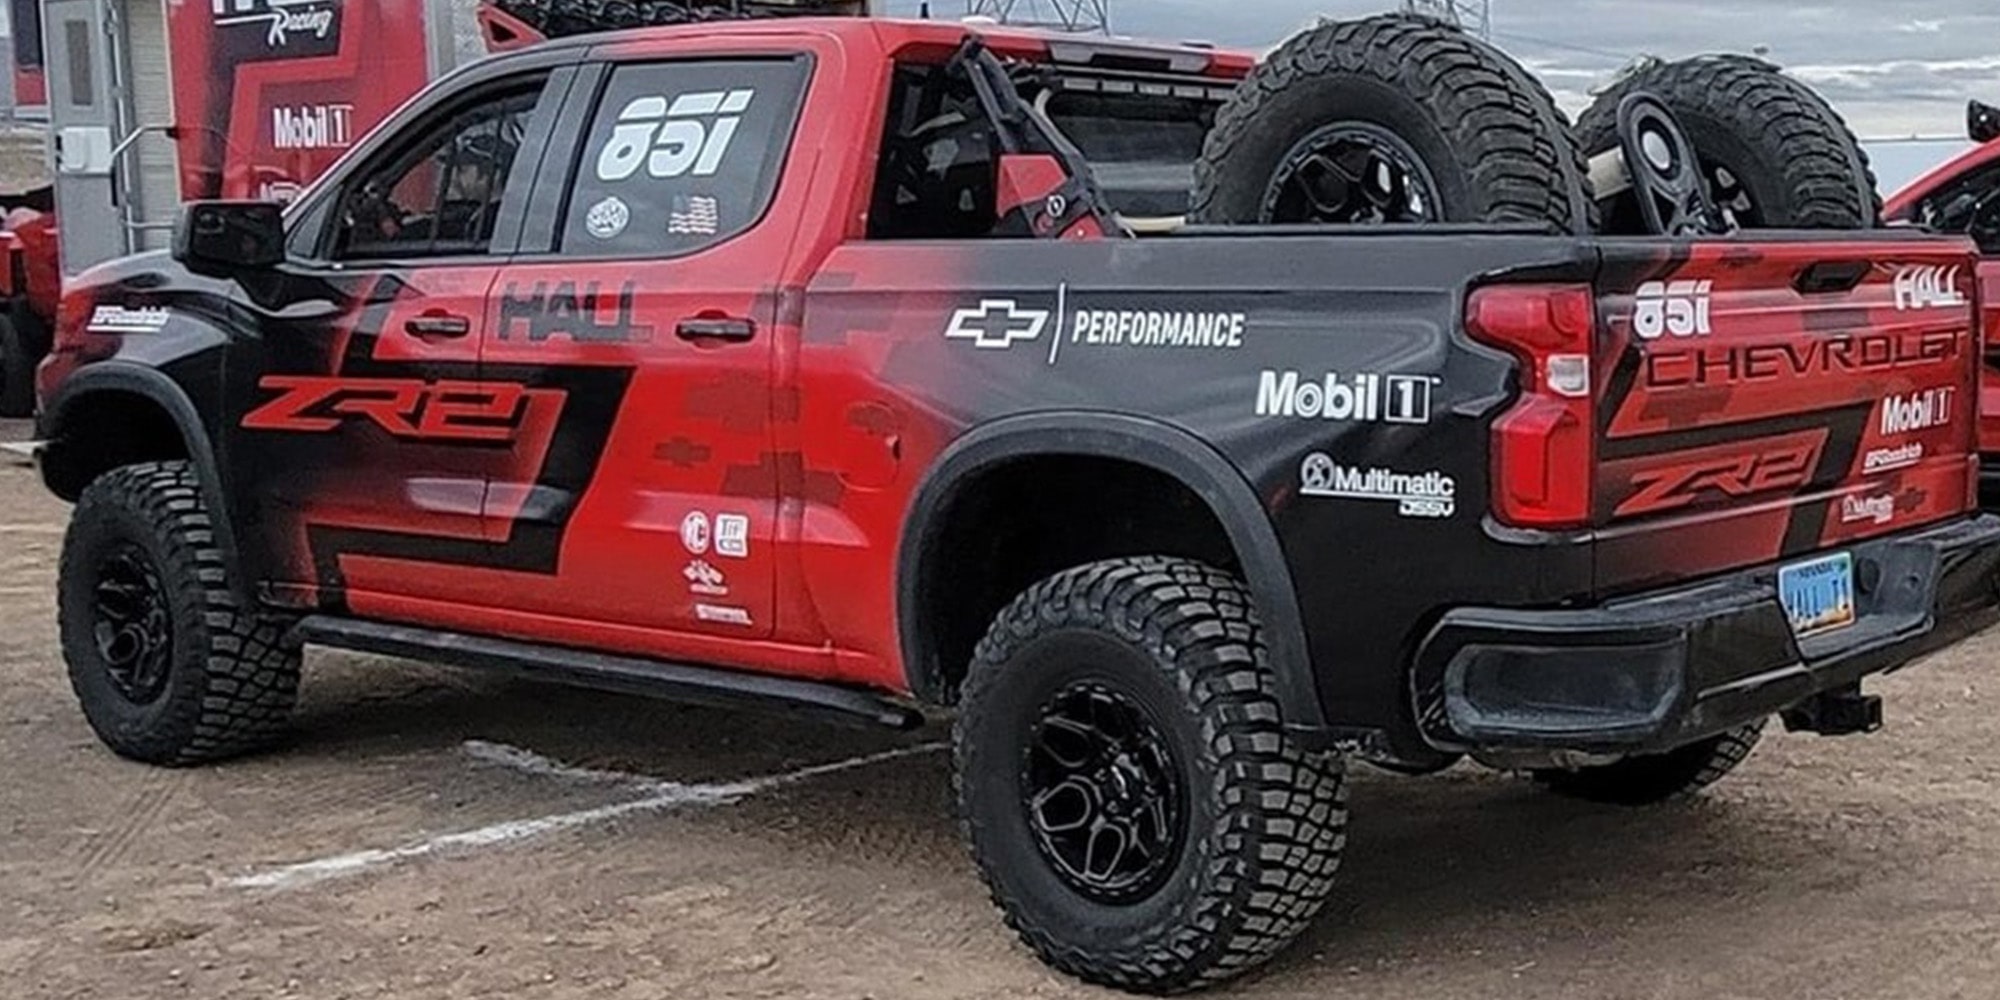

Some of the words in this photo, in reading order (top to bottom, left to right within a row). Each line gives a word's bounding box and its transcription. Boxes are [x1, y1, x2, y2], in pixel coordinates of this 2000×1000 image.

[268, 6, 332, 45] Racing
[273, 104, 328, 148] Mobil
[1893, 264, 1965, 310] HALL
[499, 280, 655, 343] HALL
[1072, 310, 1245, 347] PERFORMANCE
[1646, 331, 1967, 387] CHEVROLET
[240, 374, 524, 440] ZR2
[1255, 370, 1379, 421] Mobil
[1880, 389, 1934, 436] Mobil
[1334, 465, 1455, 496] Multimatic
[1613, 453, 1814, 516] ZR2
